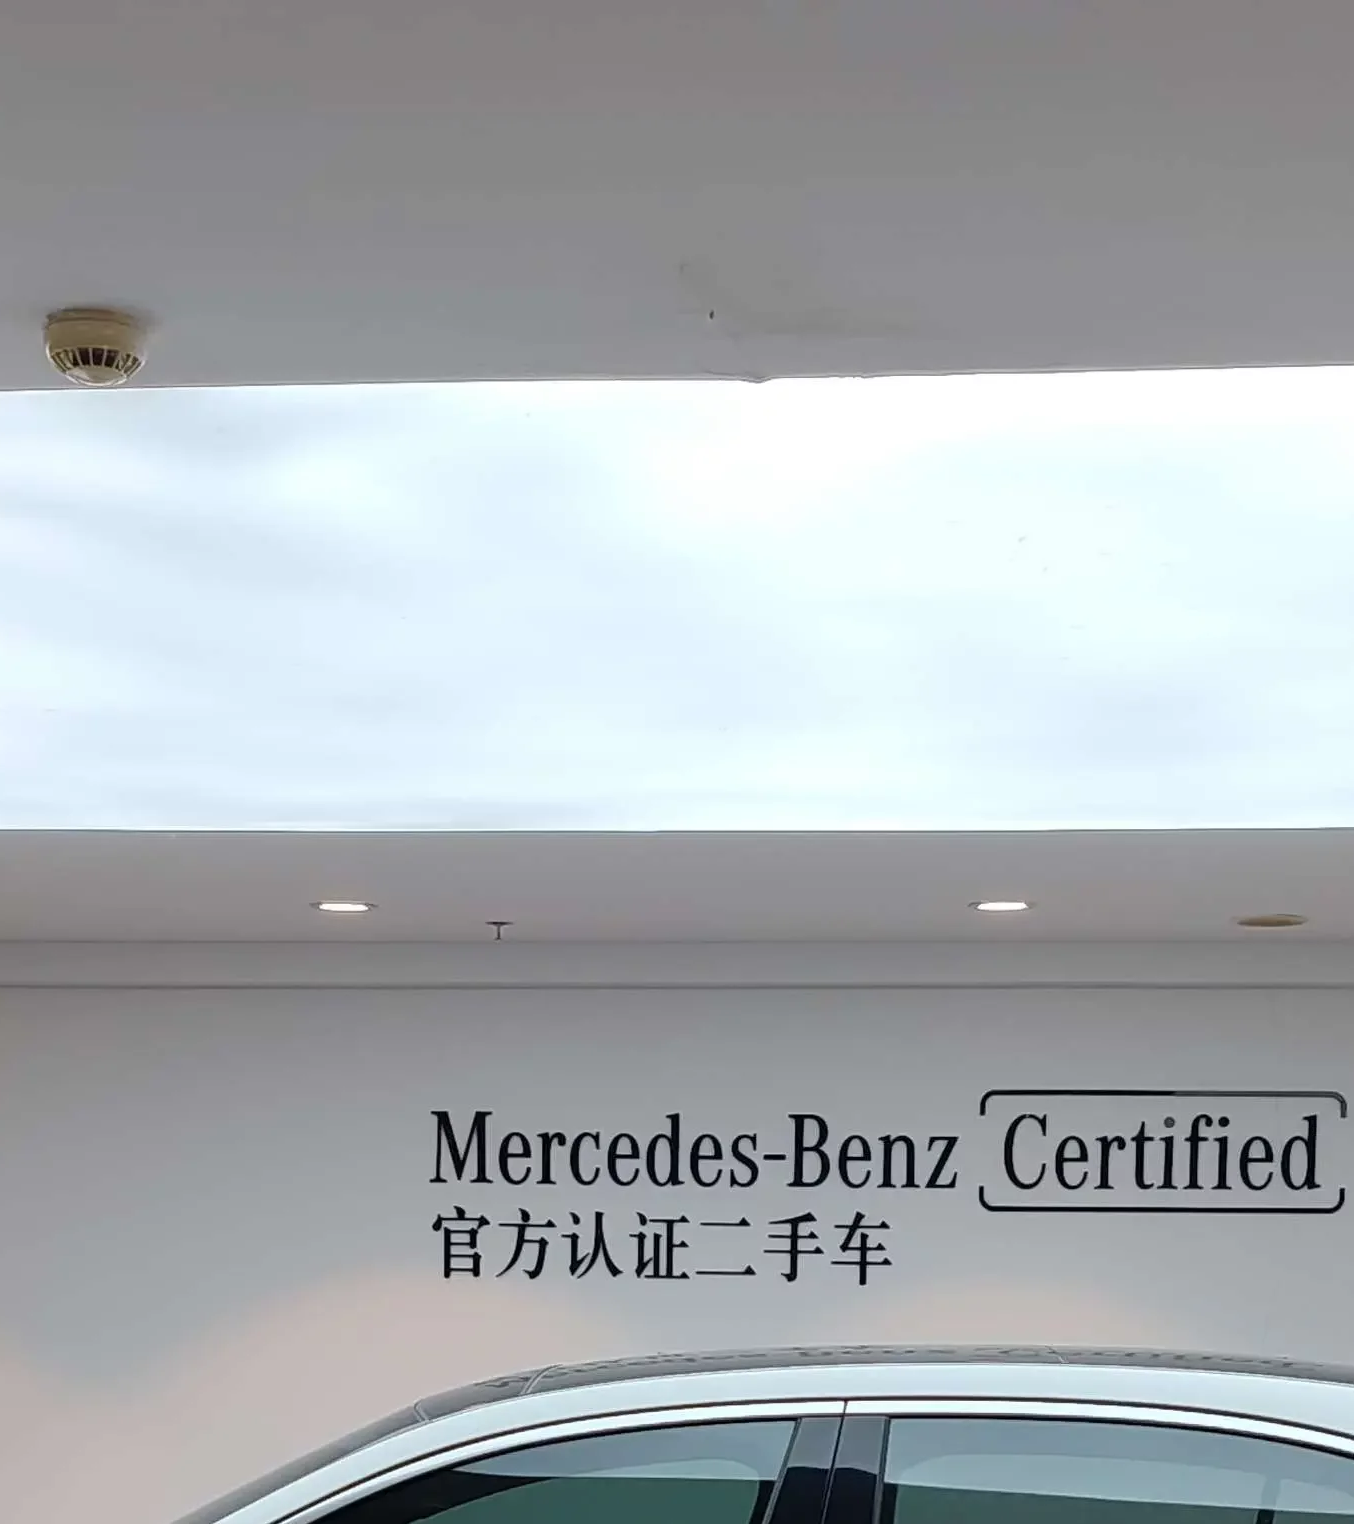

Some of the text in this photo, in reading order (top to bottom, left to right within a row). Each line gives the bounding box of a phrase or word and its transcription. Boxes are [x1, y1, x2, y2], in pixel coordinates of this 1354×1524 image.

[429, 1110, 1321, 1191] Mercedes-Benz Certified
[431, 1206, 894, 1287] 官方认证二手车
